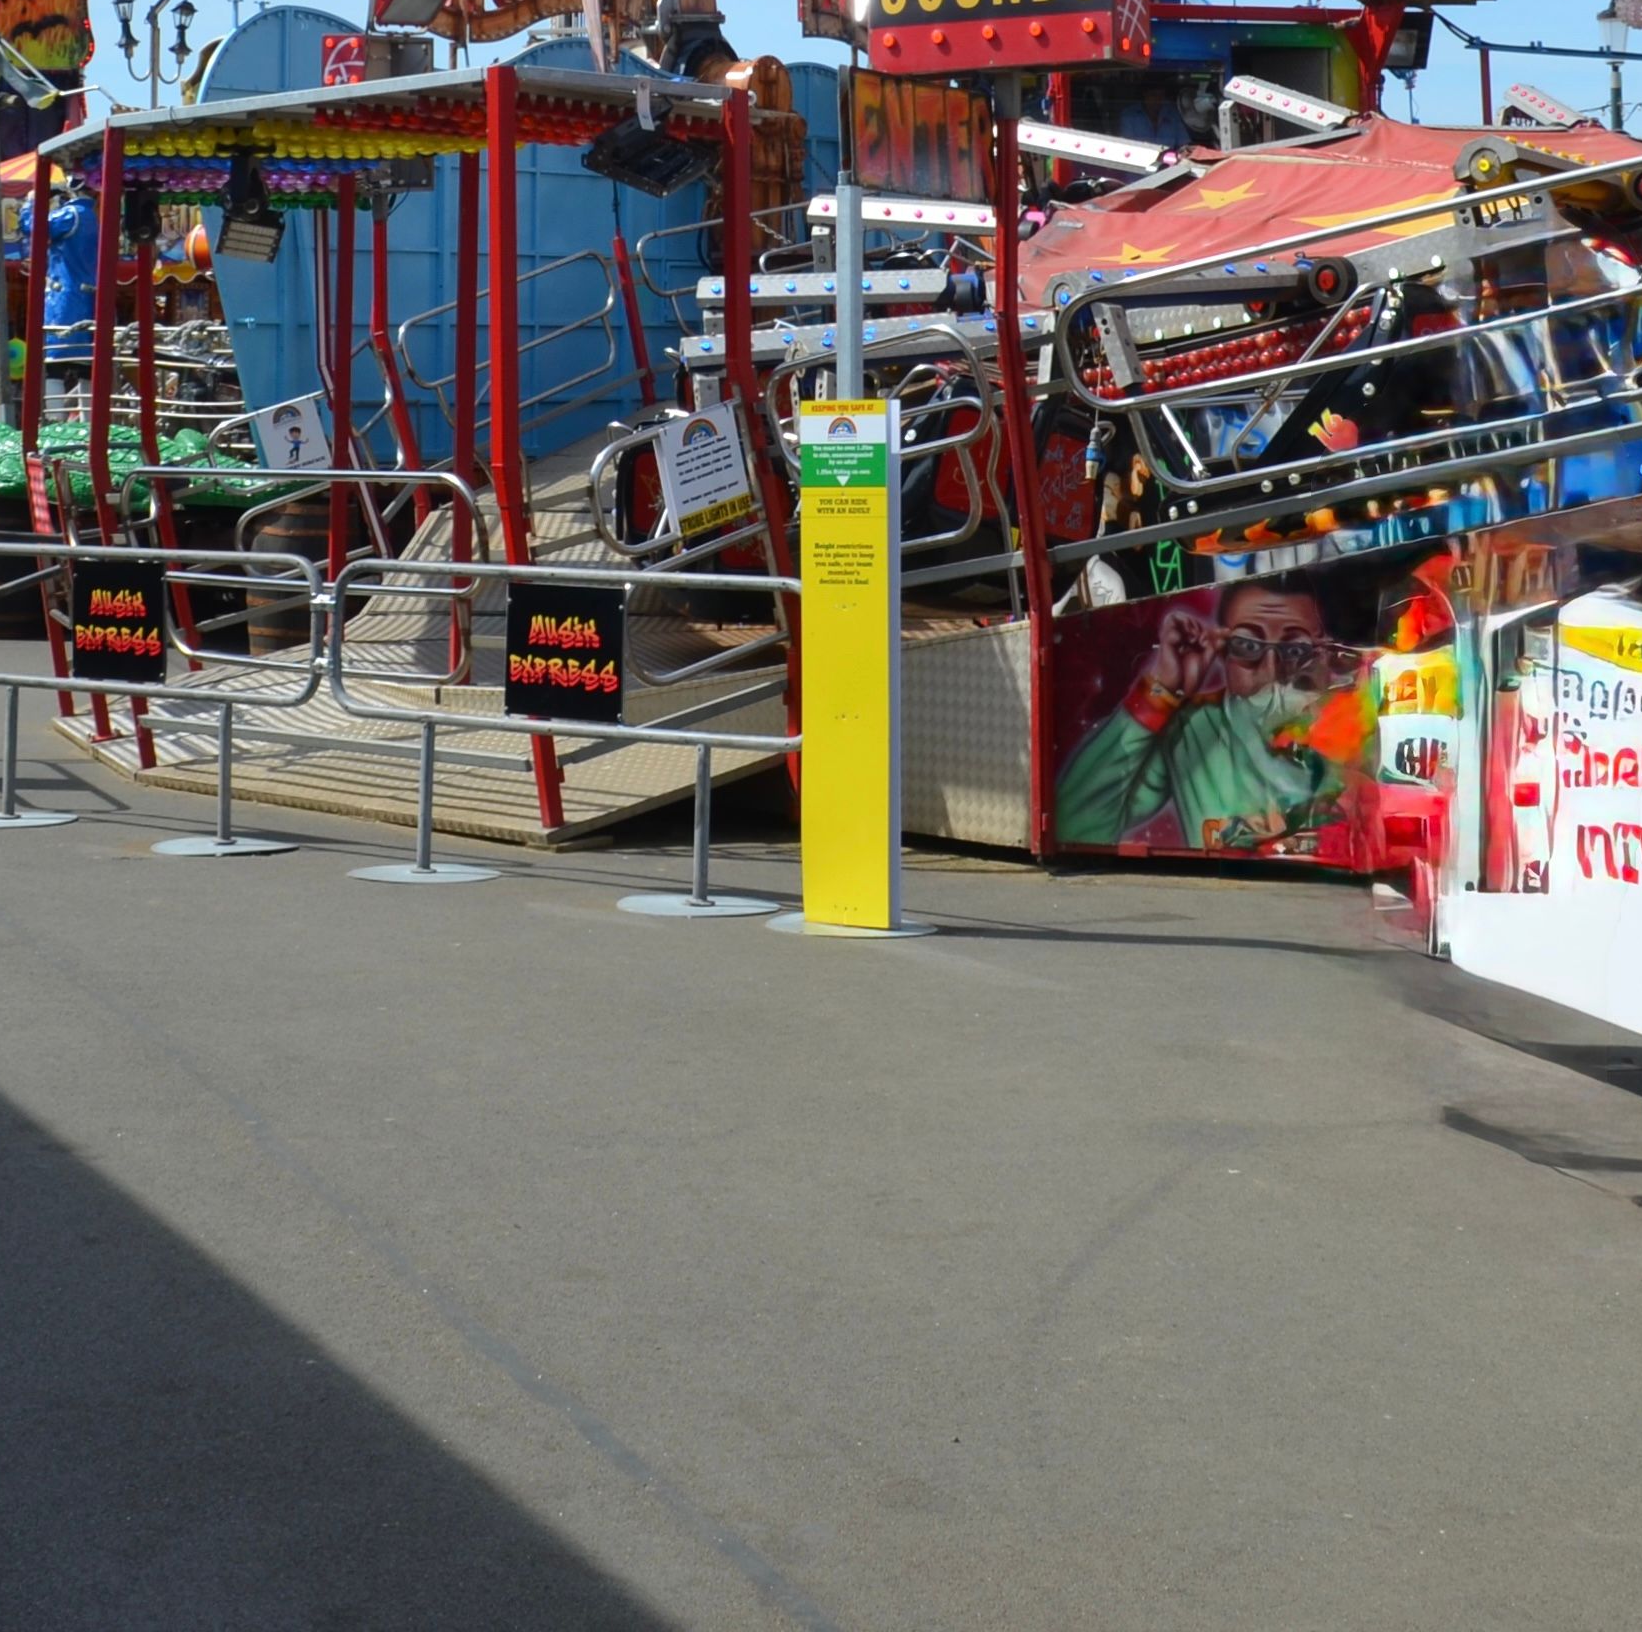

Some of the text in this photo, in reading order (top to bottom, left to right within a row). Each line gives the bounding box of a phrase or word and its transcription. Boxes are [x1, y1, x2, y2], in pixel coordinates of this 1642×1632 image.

[855, 69, 995, 200] ENTER
[811, 404, 835, 412] KEEPING
[75, 624, 162, 656] EXPRESS
[509, 653, 619, 693] EXPRESS
